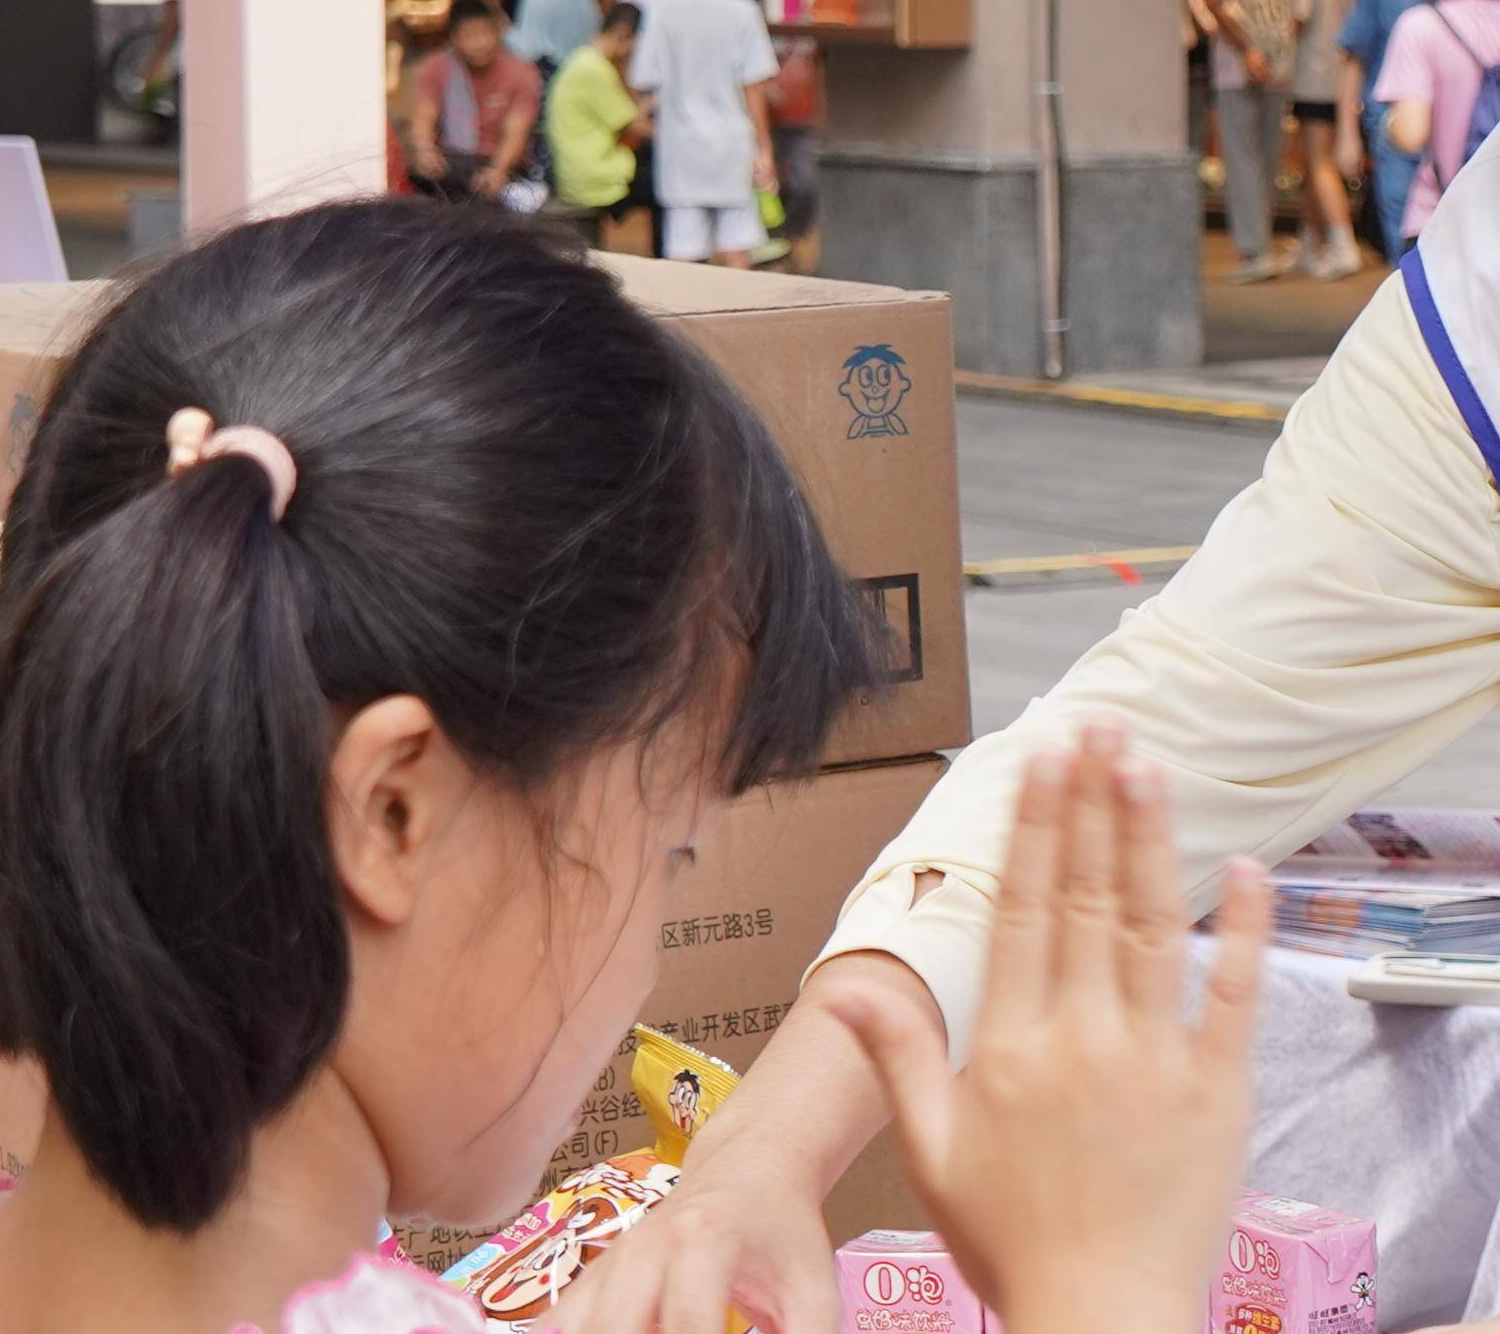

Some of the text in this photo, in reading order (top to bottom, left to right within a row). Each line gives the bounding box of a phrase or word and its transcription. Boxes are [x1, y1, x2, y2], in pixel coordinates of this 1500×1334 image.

[656, 908, 775, 949] 区新元路3号
[579, 1094, 647, 1126] 兴谷经
